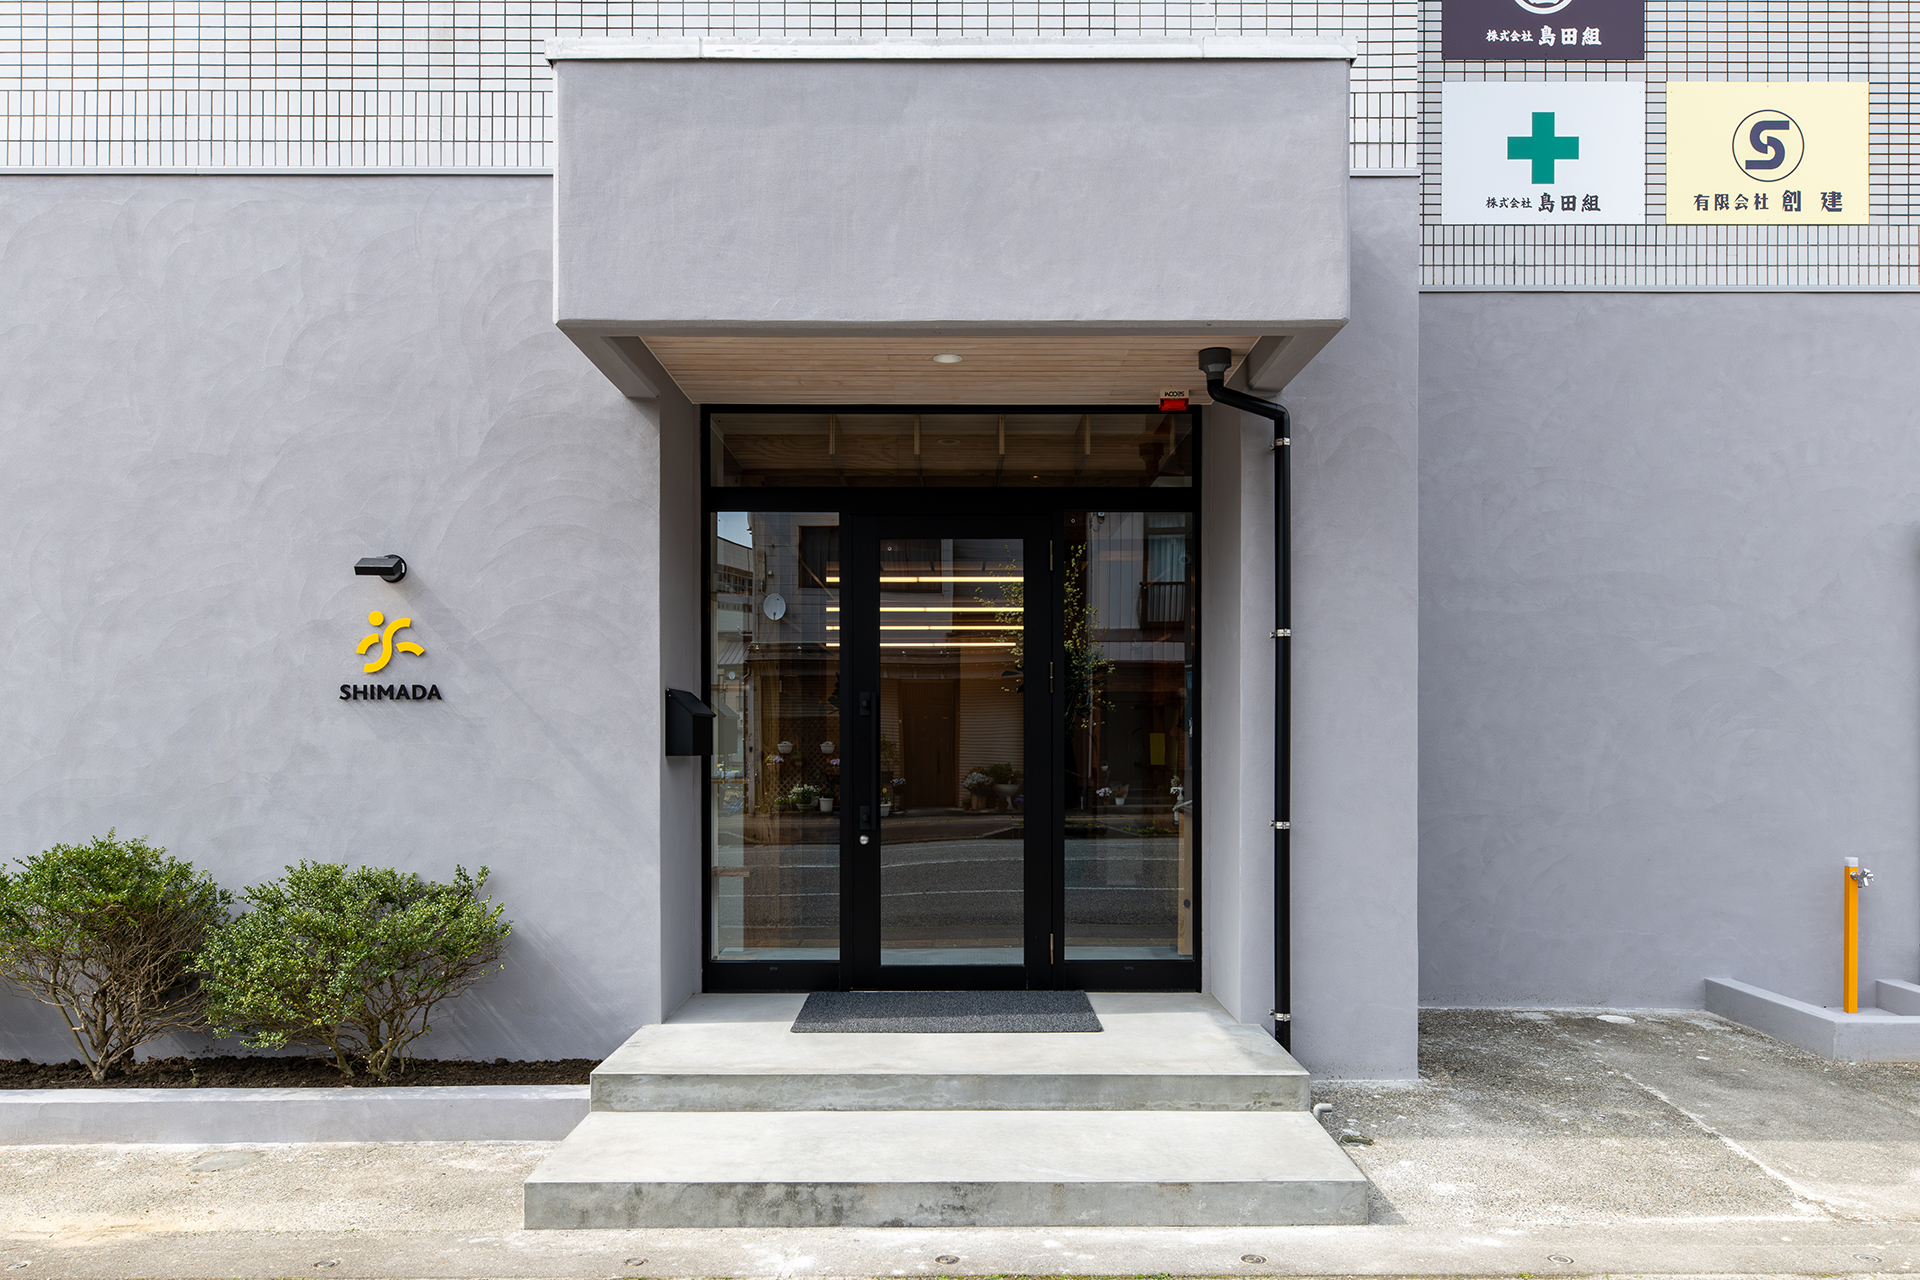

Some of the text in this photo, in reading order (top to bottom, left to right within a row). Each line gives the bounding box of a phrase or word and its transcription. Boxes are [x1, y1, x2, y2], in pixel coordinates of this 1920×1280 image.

[1485, 25, 1602, 47] 株式会社 島田組
[1485, 192, 1601, 213] 株式会社 島田組
[1693, 193, 1769, 211] 有限会社
[339, 684, 443, 701] SHIMADA
